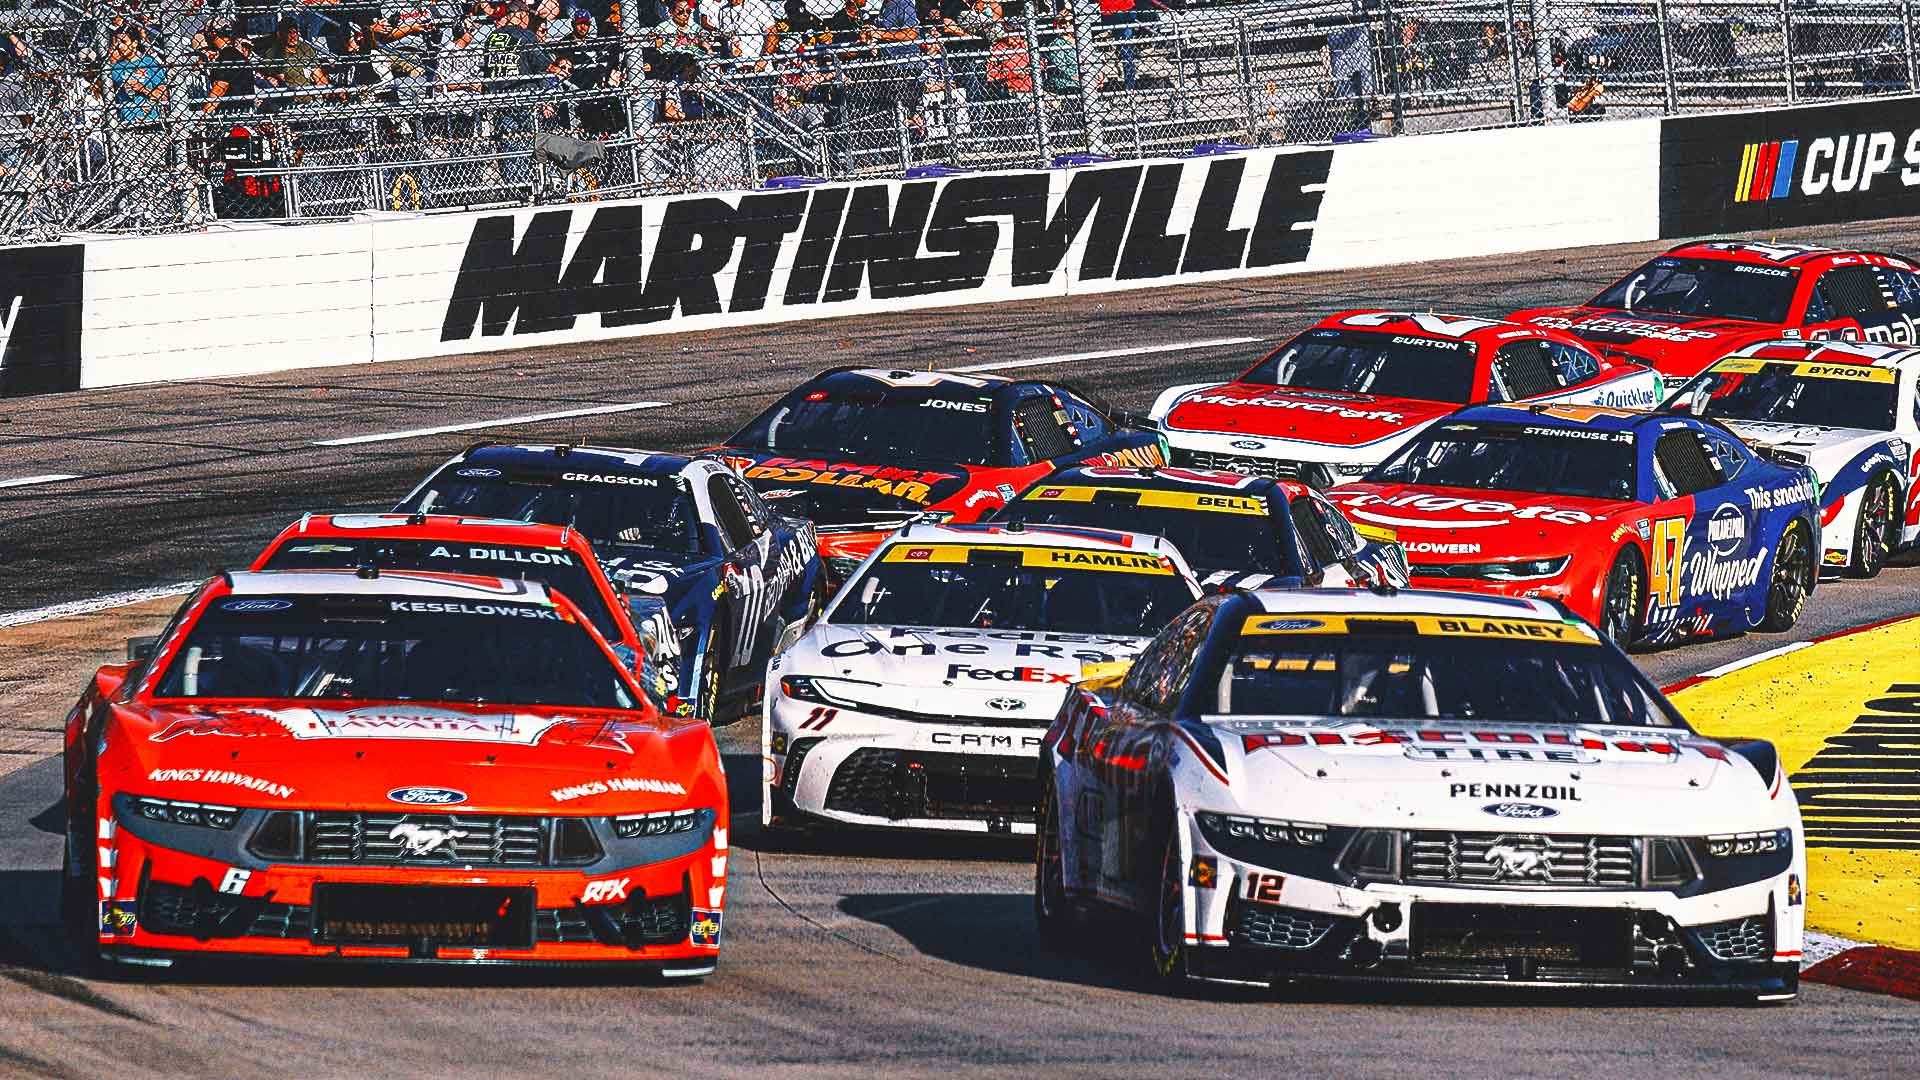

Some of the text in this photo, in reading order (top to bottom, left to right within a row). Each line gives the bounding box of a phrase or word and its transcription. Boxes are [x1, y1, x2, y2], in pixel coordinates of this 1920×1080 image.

[1801, 131, 1896, 196] CUP
[441, 150, 1334, 341] MARTINSVILLE
[1734, 265, 1790, 277] BRISCOE
[1392, 336, 1460, 351] BURTON
[1807, 366, 1872, 378] BYRON
[920, 398, 987, 413] JONES
[1182, 394, 1404, 424] Motorcraft
[1523, 426, 1609, 441] STENHOUSE
[562, 472, 658, 488] GRAGSON
[1197, 497, 1255, 511] BELL
[1743, 484, 1771, 510] This
[430, 545, 573, 567] A. DILLON
[1402, 540, 1481, 554] LLOWEEN
[1051, 551, 1164, 570] HAMLIN
[1651, 518, 1687, 608] 47
[1690, 546, 1769, 601] Whipped
[228, 600, 280, 611] Ford
[1263, 619, 1320, 631] Ford
[1439, 620, 1565, 639] BLANEY
[821, 638, 989, 660] One
[946, 663, 1075, 685] FedEx
[798, 706, 839, 731] 11
[1420, 747, 1578, 764] TIRE
[202, 769, 296, 799] HAWAIIAN
[1450, 782, 1582, 801] PENNZOIL
[397, 788, 457, 804] Ford
[1491, 803, 1553, 818] Ford
[218, 867, 252, 896] 6
[1246, 870, 1287, 904] 12
